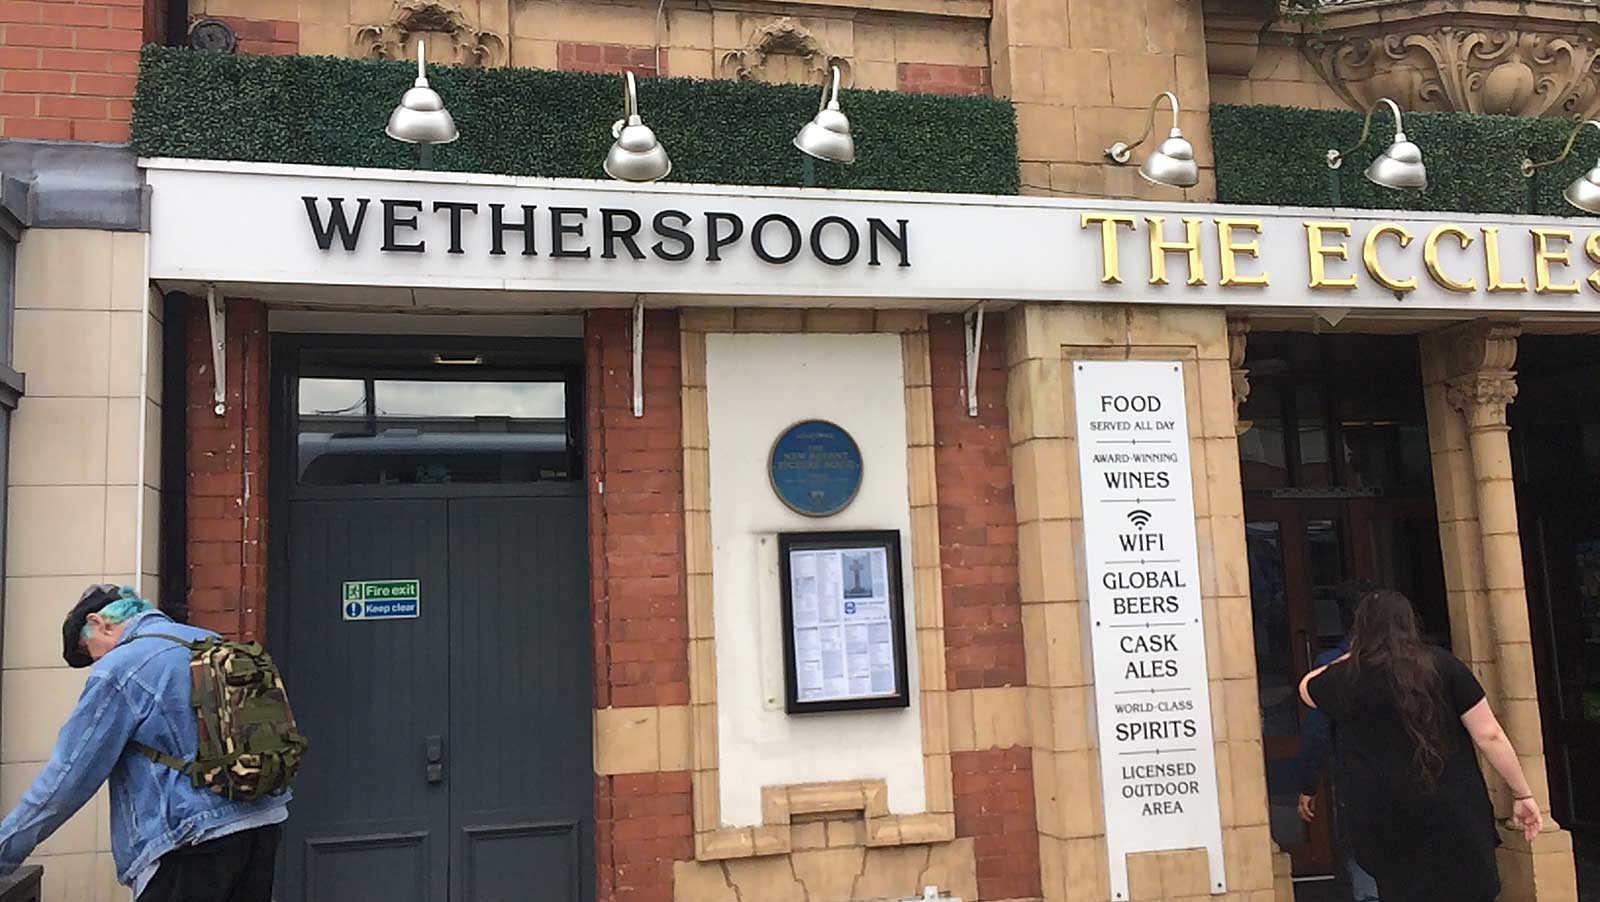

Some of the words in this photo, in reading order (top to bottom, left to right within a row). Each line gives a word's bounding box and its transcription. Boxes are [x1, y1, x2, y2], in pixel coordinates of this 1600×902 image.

[301, 197, 909, 268] WETHERSPOON
[1080, 213, 1269, 287] THE
[1101, 395, 1161, 413] FOOD
[1090, 421, 1131, 431] SERVED
[1133, 421, 1153, 431] ALL
[1155, 421, 1175, 431] DAY
[1093, 453, 1178, 463] AWARD-WINNING
[1104, 471, 1170, 489] WINES
[1118, 533, 1165, 552] WIFI
[1102, 570, 1186, 590] GLOBAL
[366, 585, 390, 597] Fire
[391, 584, 416, 595] exit
[366, 604, 390, 614] Keep
[391, 603, 416, 612] clear
[1113, 595, 1180, 615] BEERS
[1120, 634, 1178, 654] CASK
[1125, 659, 1178, 679] ALES
[1115, 700, 1194, 714] WORLD-CLASS
[1115, 719, 1197, 742] SPIRITS
[1122, 763, 1196, 780] LICENSED
[1122, 782, 1199, 799] OUTDOOR
[1142, 801, 1184, 817] AREA
